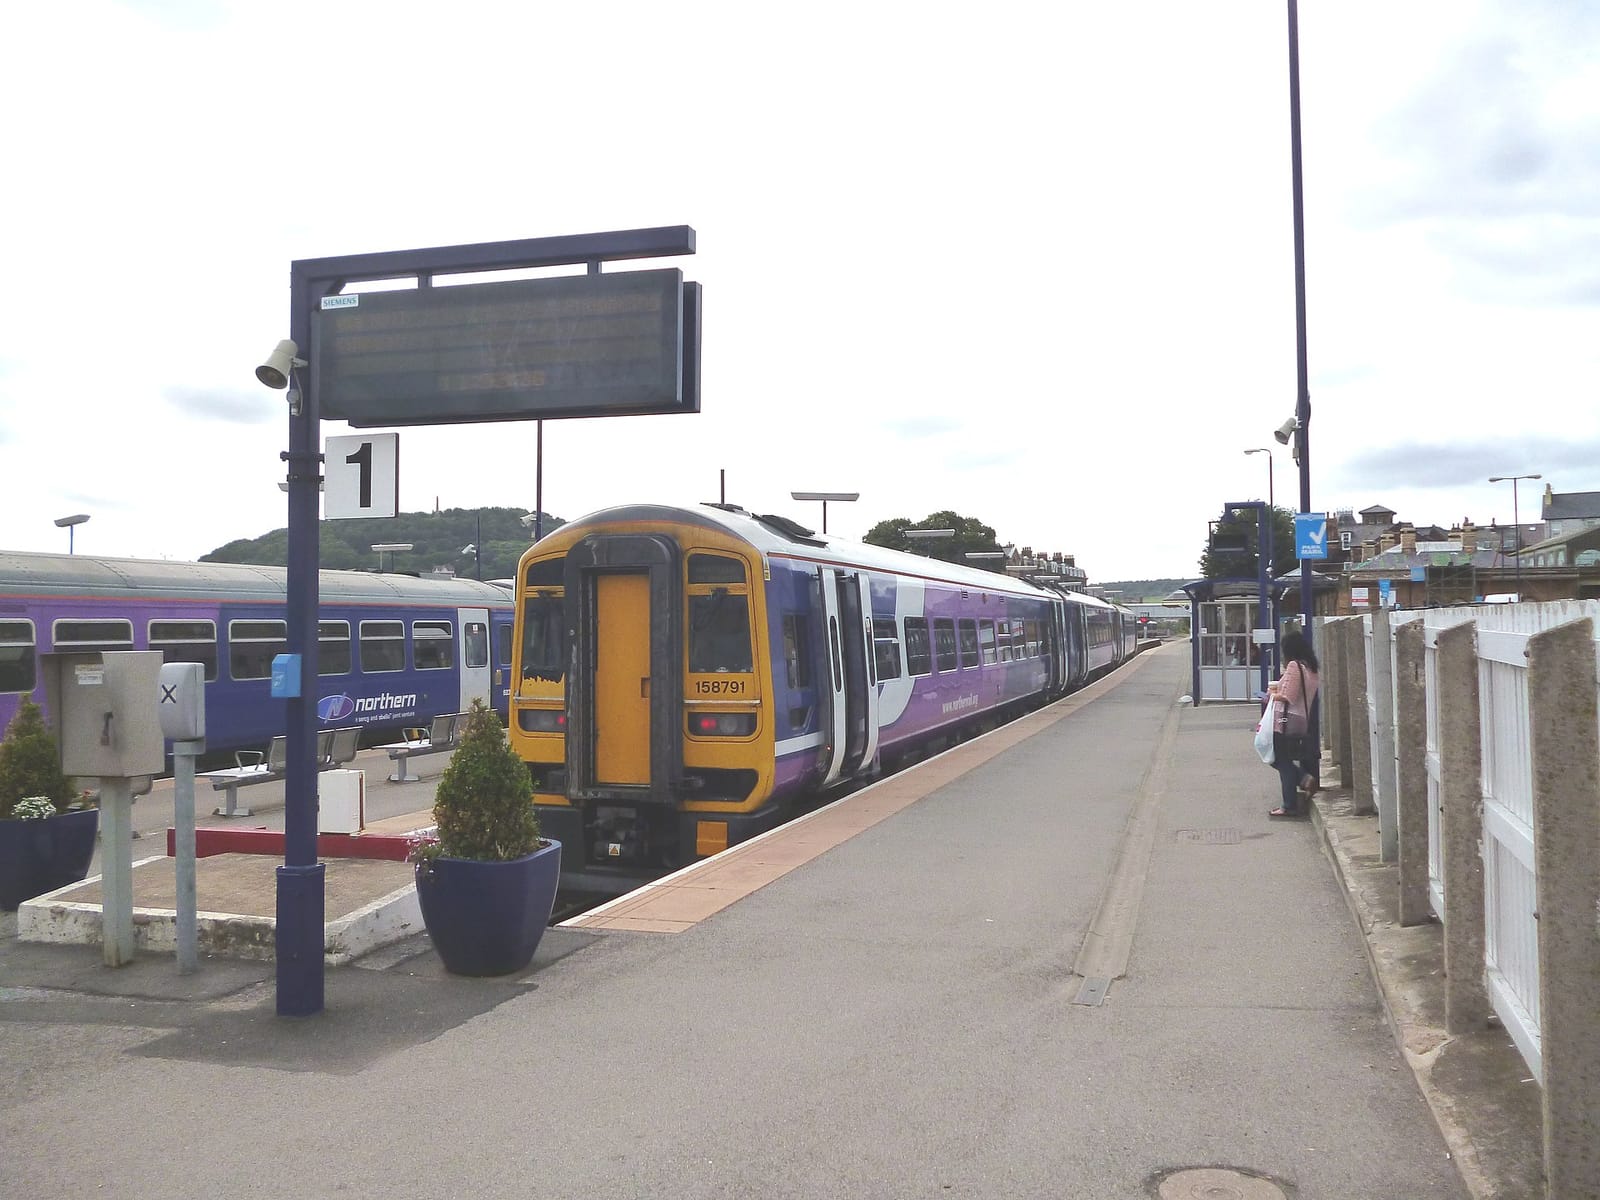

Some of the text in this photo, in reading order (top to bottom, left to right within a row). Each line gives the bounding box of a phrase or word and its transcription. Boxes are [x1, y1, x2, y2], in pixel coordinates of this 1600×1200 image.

[323, 297, 356, 307] SIEMENS
[346, 442, 372, 508] 1
[695, 681, 745, 694] 158791
[355, 692, 417, 712] northern
